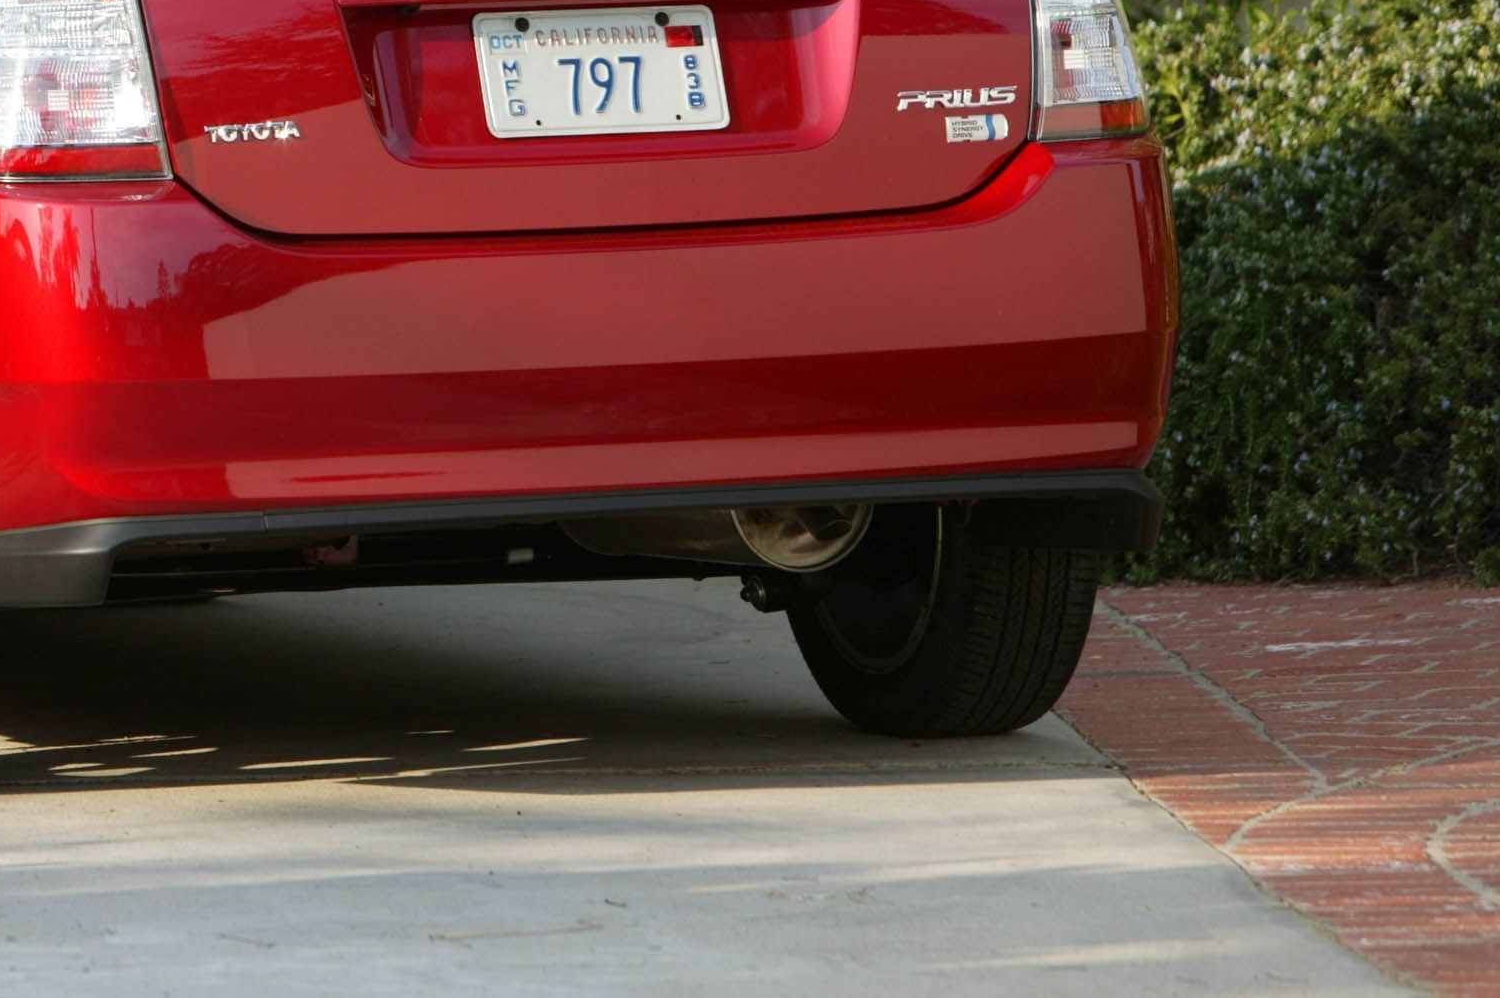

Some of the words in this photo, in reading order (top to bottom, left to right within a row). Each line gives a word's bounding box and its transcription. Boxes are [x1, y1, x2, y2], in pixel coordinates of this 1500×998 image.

[489, 34, 522, 50] OCT
[535, 25, 658, 47] CALIFORNIA
[557, 56, 642, 115] 797
[897, 85, 1018, 111] PRIUS
[204, 121, 300, 143] TOYOTA
